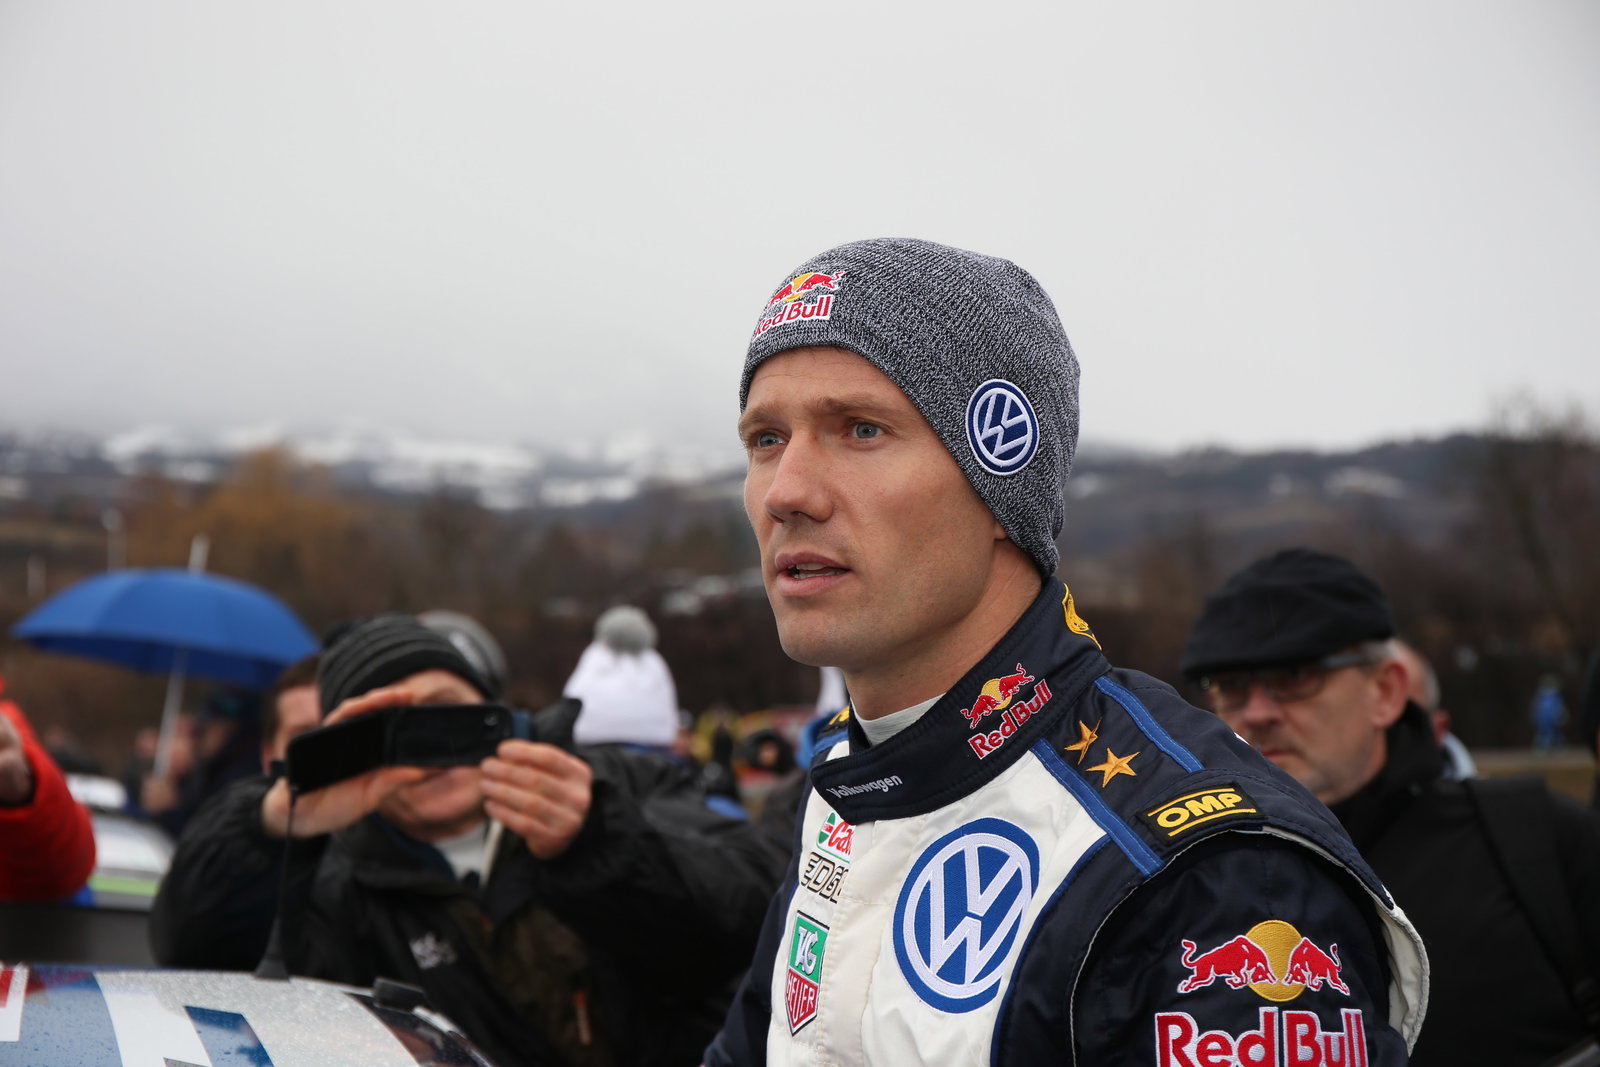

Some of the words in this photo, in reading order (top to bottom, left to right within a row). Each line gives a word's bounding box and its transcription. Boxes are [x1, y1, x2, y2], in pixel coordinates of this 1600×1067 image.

[753, 304, 788, 335] Red
[786, 295, 833, 320] Bull
[968, 711, 1018, 759] Red
[1010, 679, 1052, 726] Bull
[826, 775, 903, 799] Volkswagen
[1157, 793, 1243, 828] OMP
[795, 924, 819, 975] TAG
[786, 973, 815, 1023] HEUER
[1155, 1006, 1279, 1067] Red
[1282, 1008, 1369, 1067] Bull
